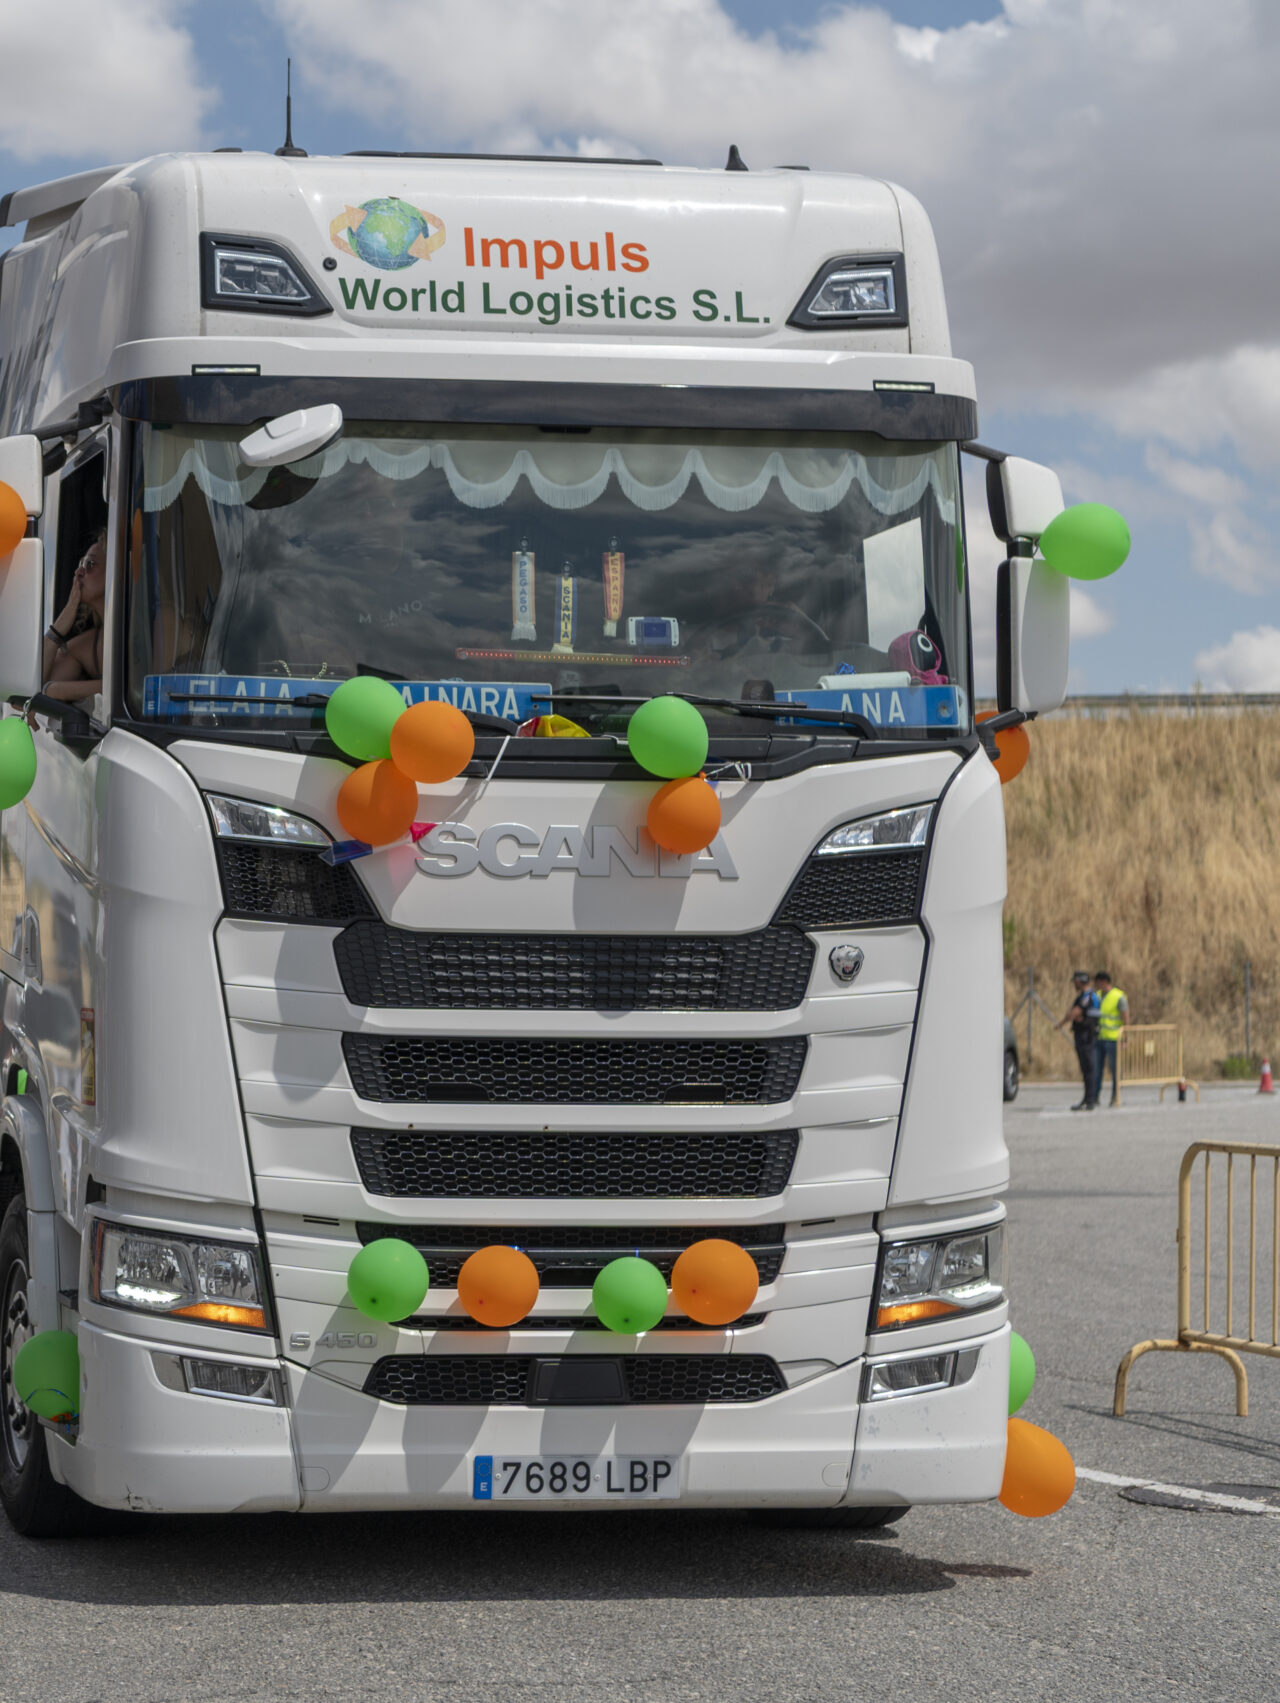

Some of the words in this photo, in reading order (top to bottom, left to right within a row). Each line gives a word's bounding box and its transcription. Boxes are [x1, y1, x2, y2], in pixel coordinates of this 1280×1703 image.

[463, 227, 651, 280] Impuls
[338, 277, 466, 313] World
[482, 282, 677, 325] Logistics
[692, 289, 771, 324] S.L.
[519, 560, 528, 613] PEGASO
[562, 586, 571, 639] SCANIA
[840, 691, 906, 725] ANA
[415, 822, 739, 880] SCANIA
[289, 1331, 311, 1349] S
[315, 1331, 378, 1349] 450
[480, 1482, 488, 1491] E
[502, 1461, 591, 1494] 7689
[606, 1460, 671, 1493] LBP
